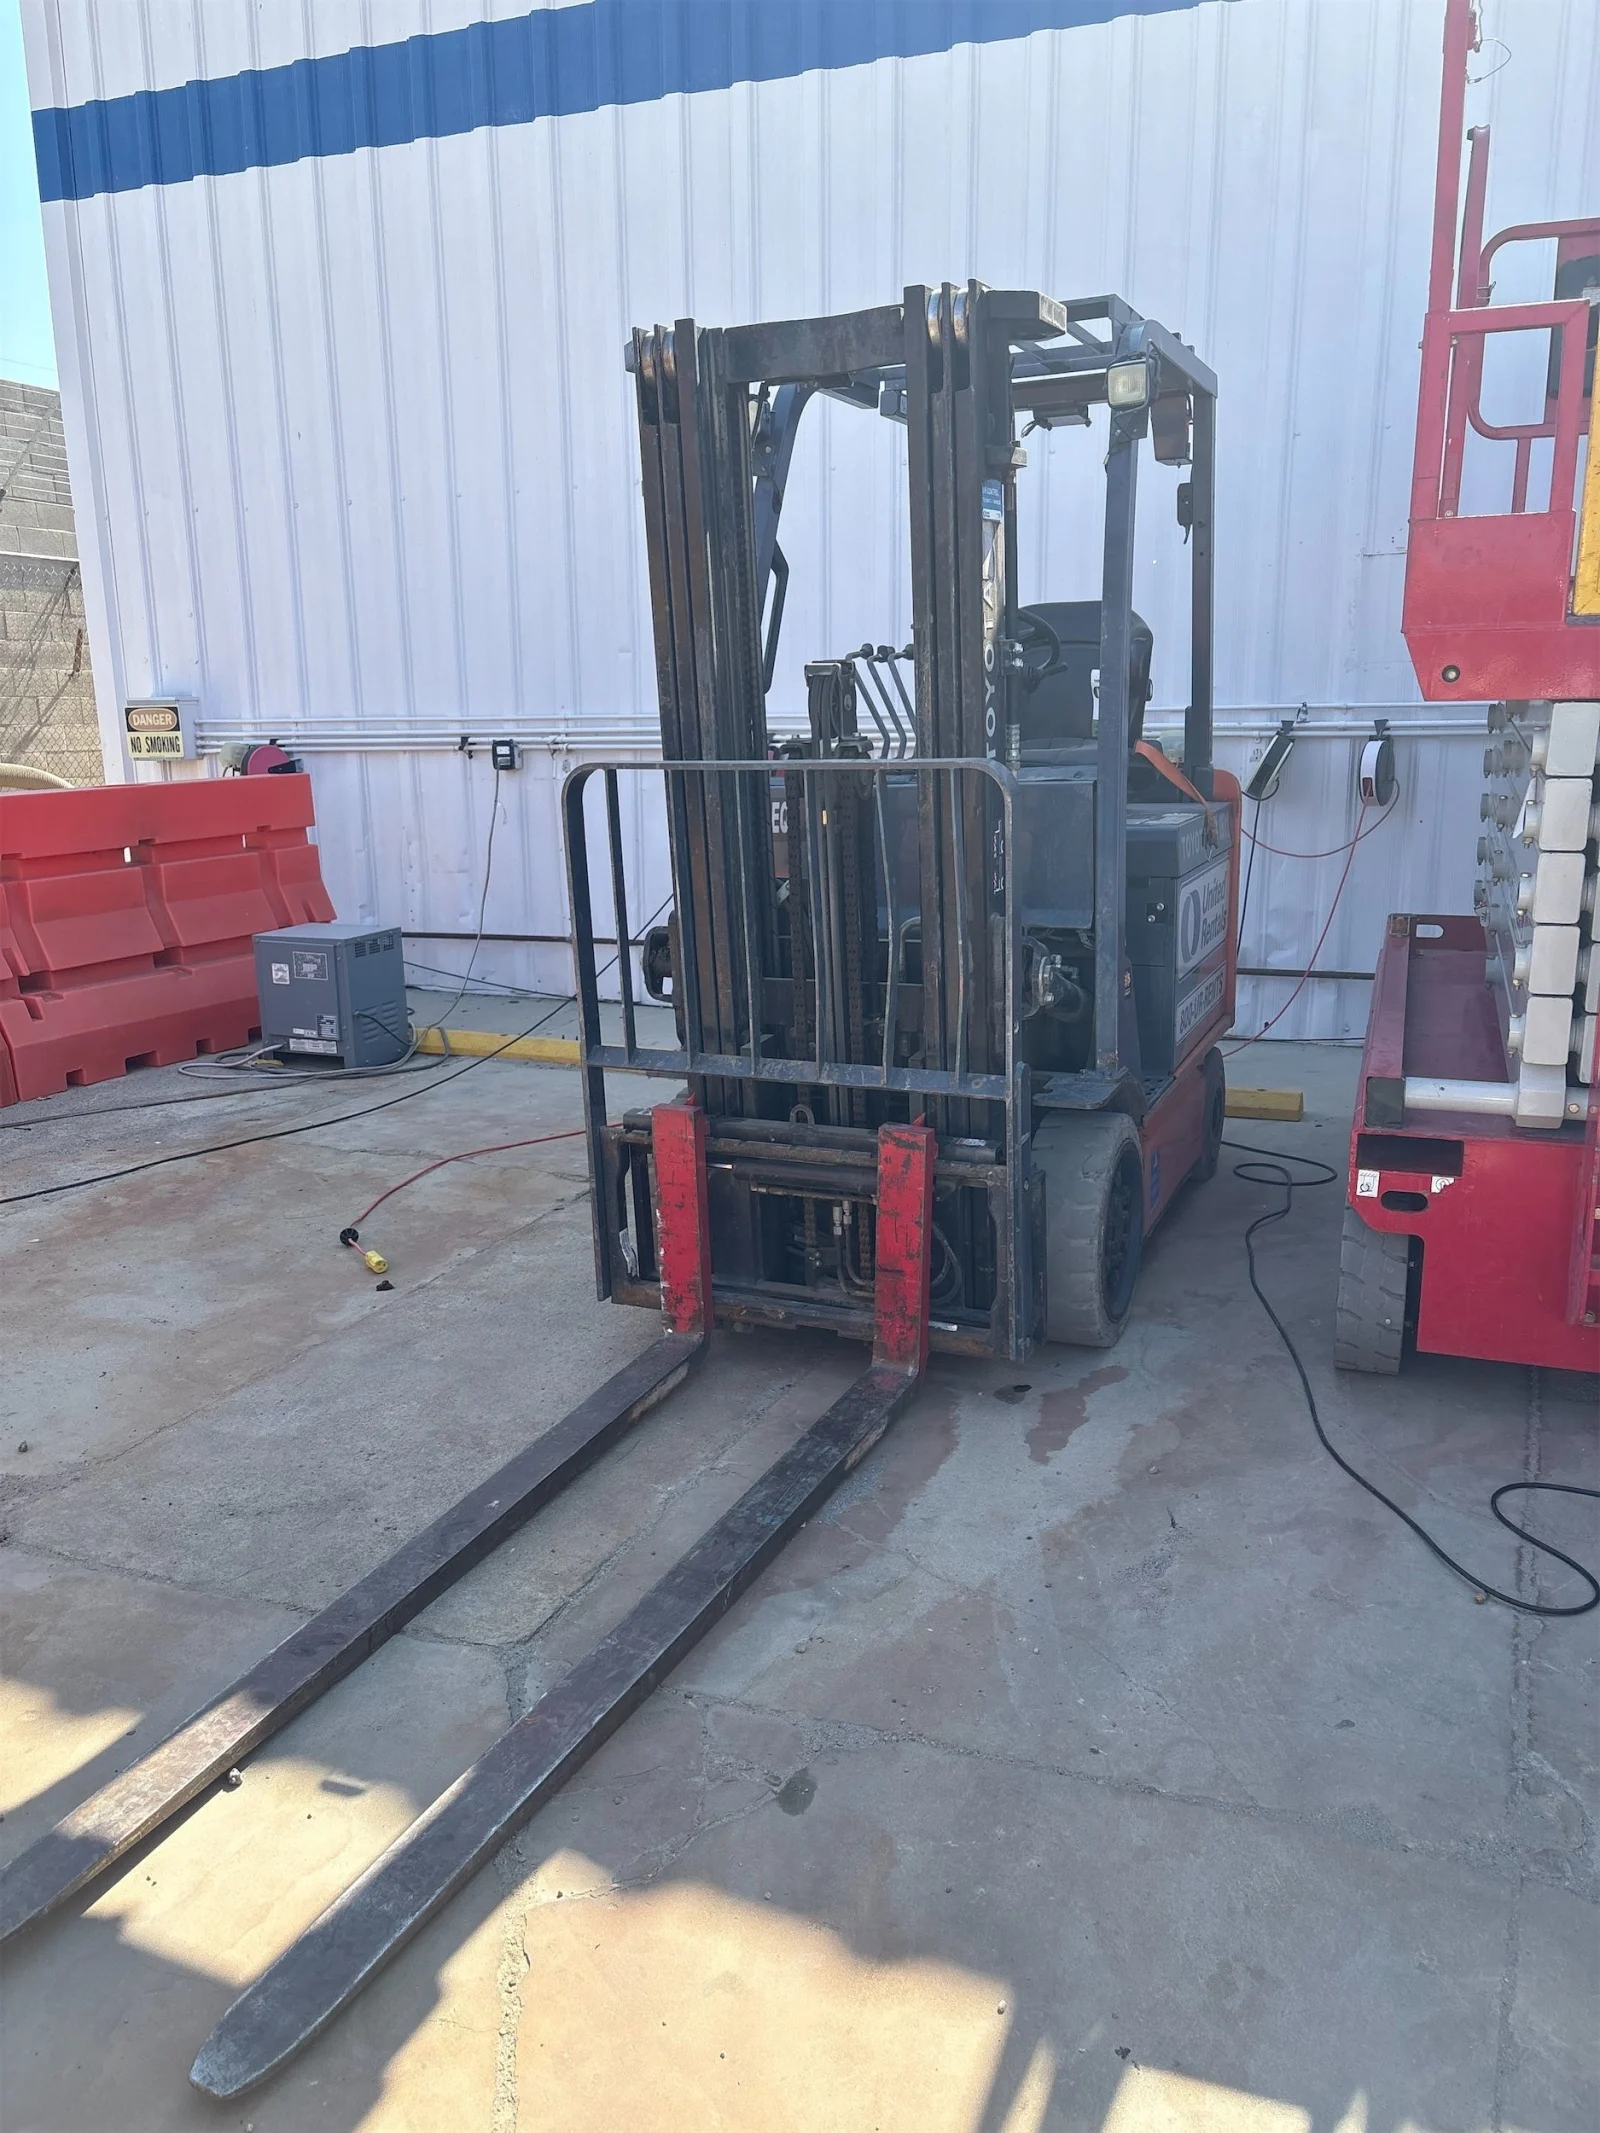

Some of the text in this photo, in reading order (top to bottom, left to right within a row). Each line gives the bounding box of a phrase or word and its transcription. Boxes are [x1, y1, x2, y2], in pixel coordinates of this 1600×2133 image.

[983, 579, 997, 760] TOYOTA
[133, 713, 172, 726] DANGER
[130, 736, 180, 753] NO SMOKING
[1202, 870, 1228, 915] United
[1200, 904, 1227, 950] Rentals
